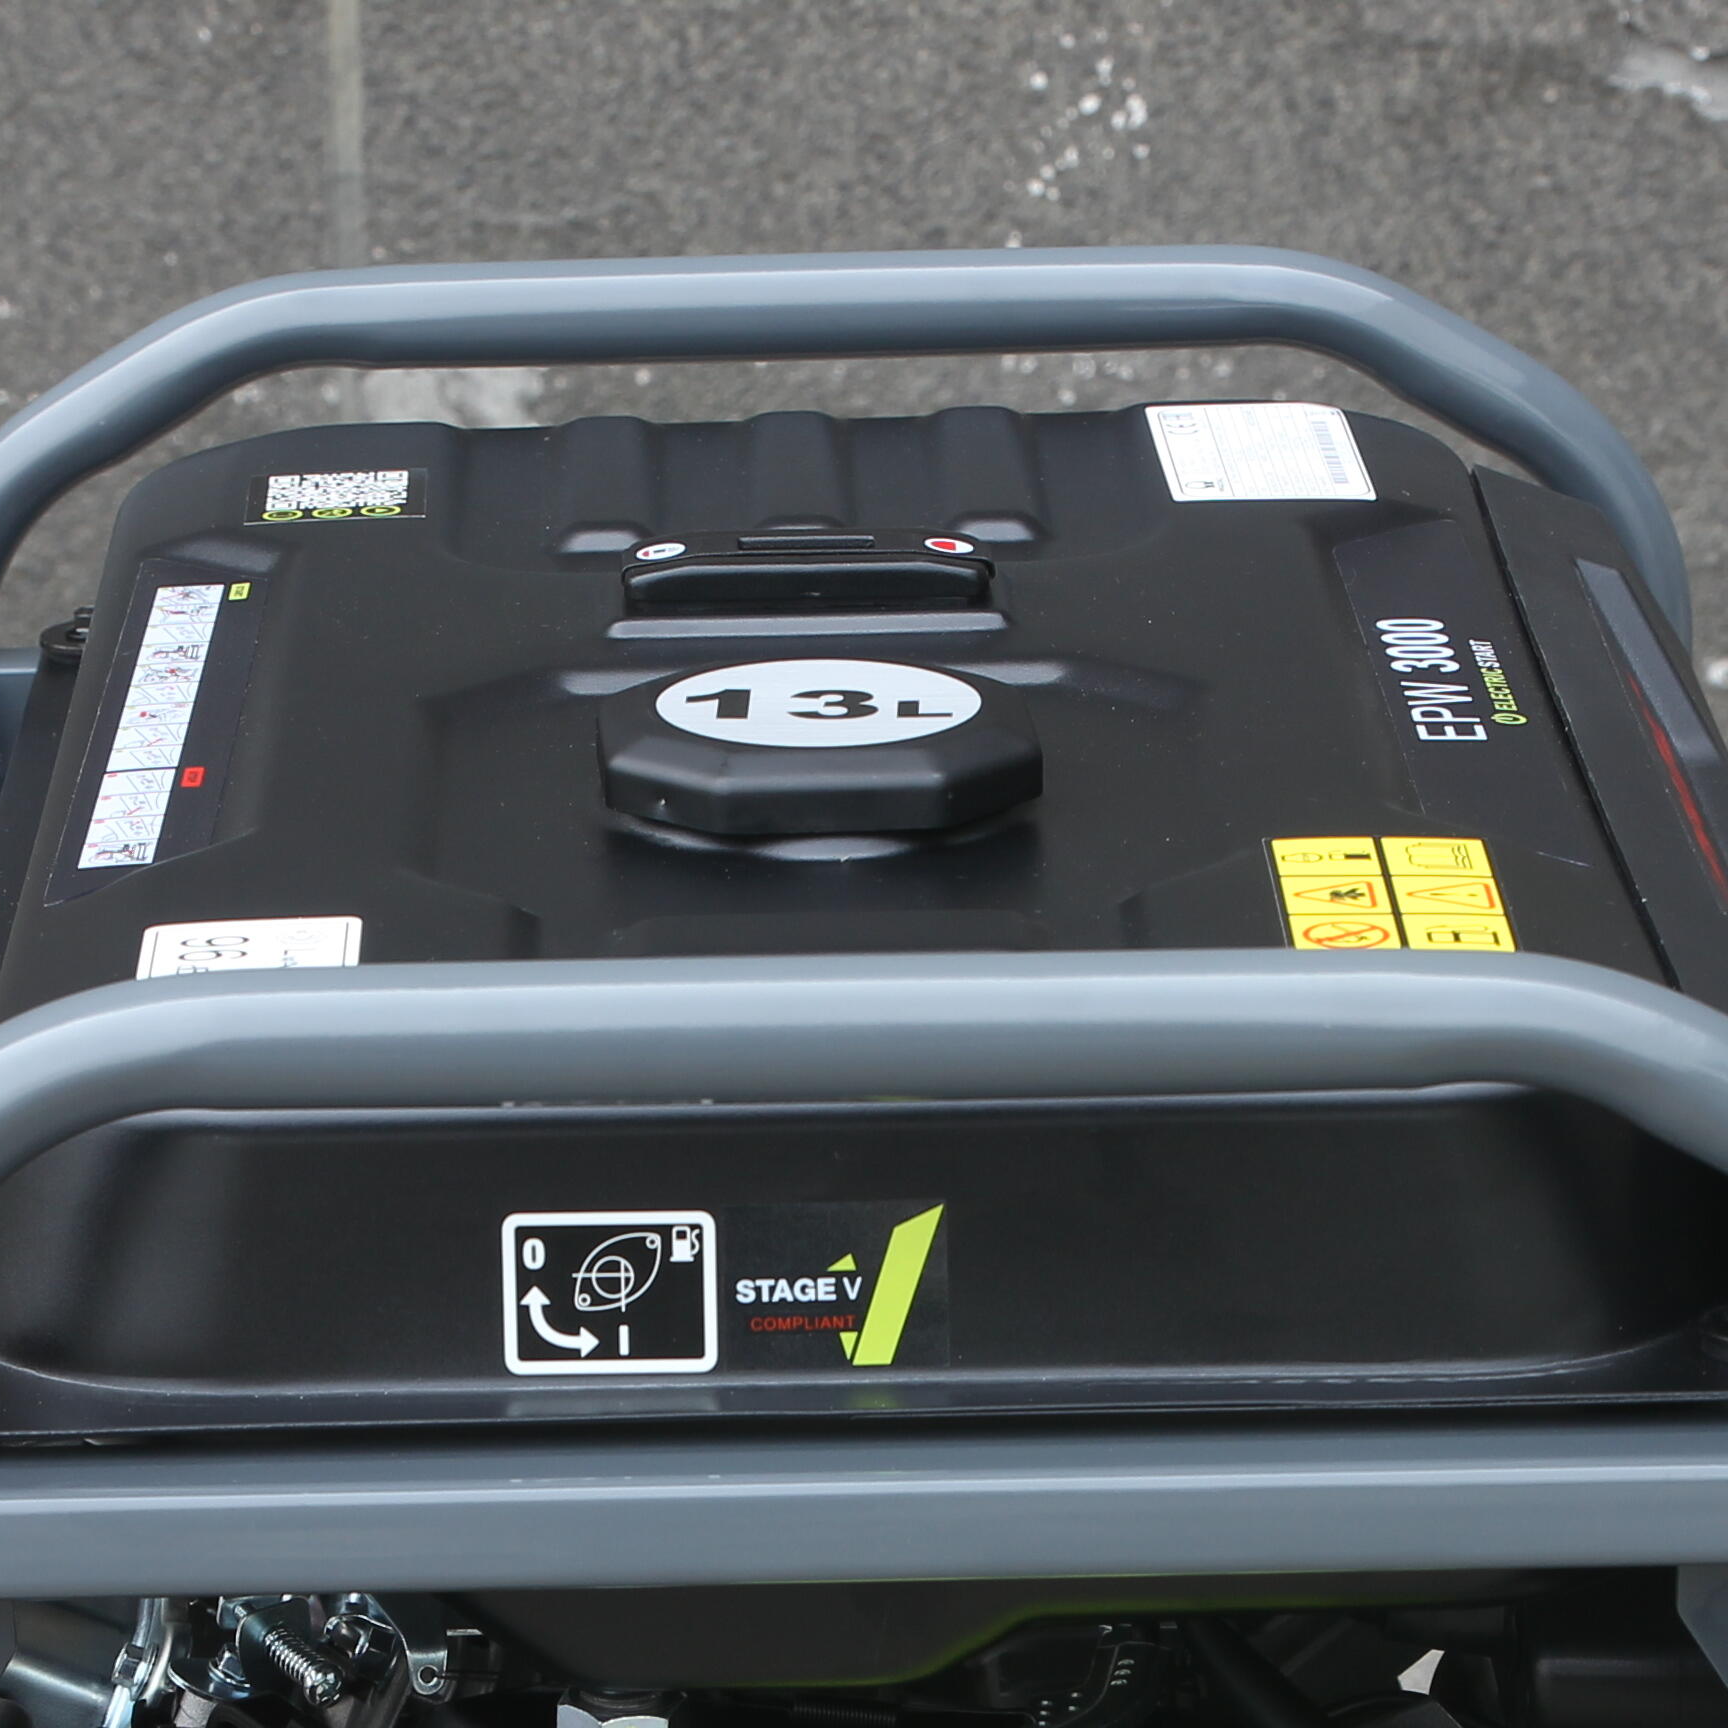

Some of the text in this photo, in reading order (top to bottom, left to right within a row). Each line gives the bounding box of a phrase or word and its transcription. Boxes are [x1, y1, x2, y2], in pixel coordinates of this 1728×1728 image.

[1375, 617, 1489, 741] EPW 3000
[734, 1275, 863, 1305] STAGE V
[749, 1314, 856, 1333] COMPLIANT
